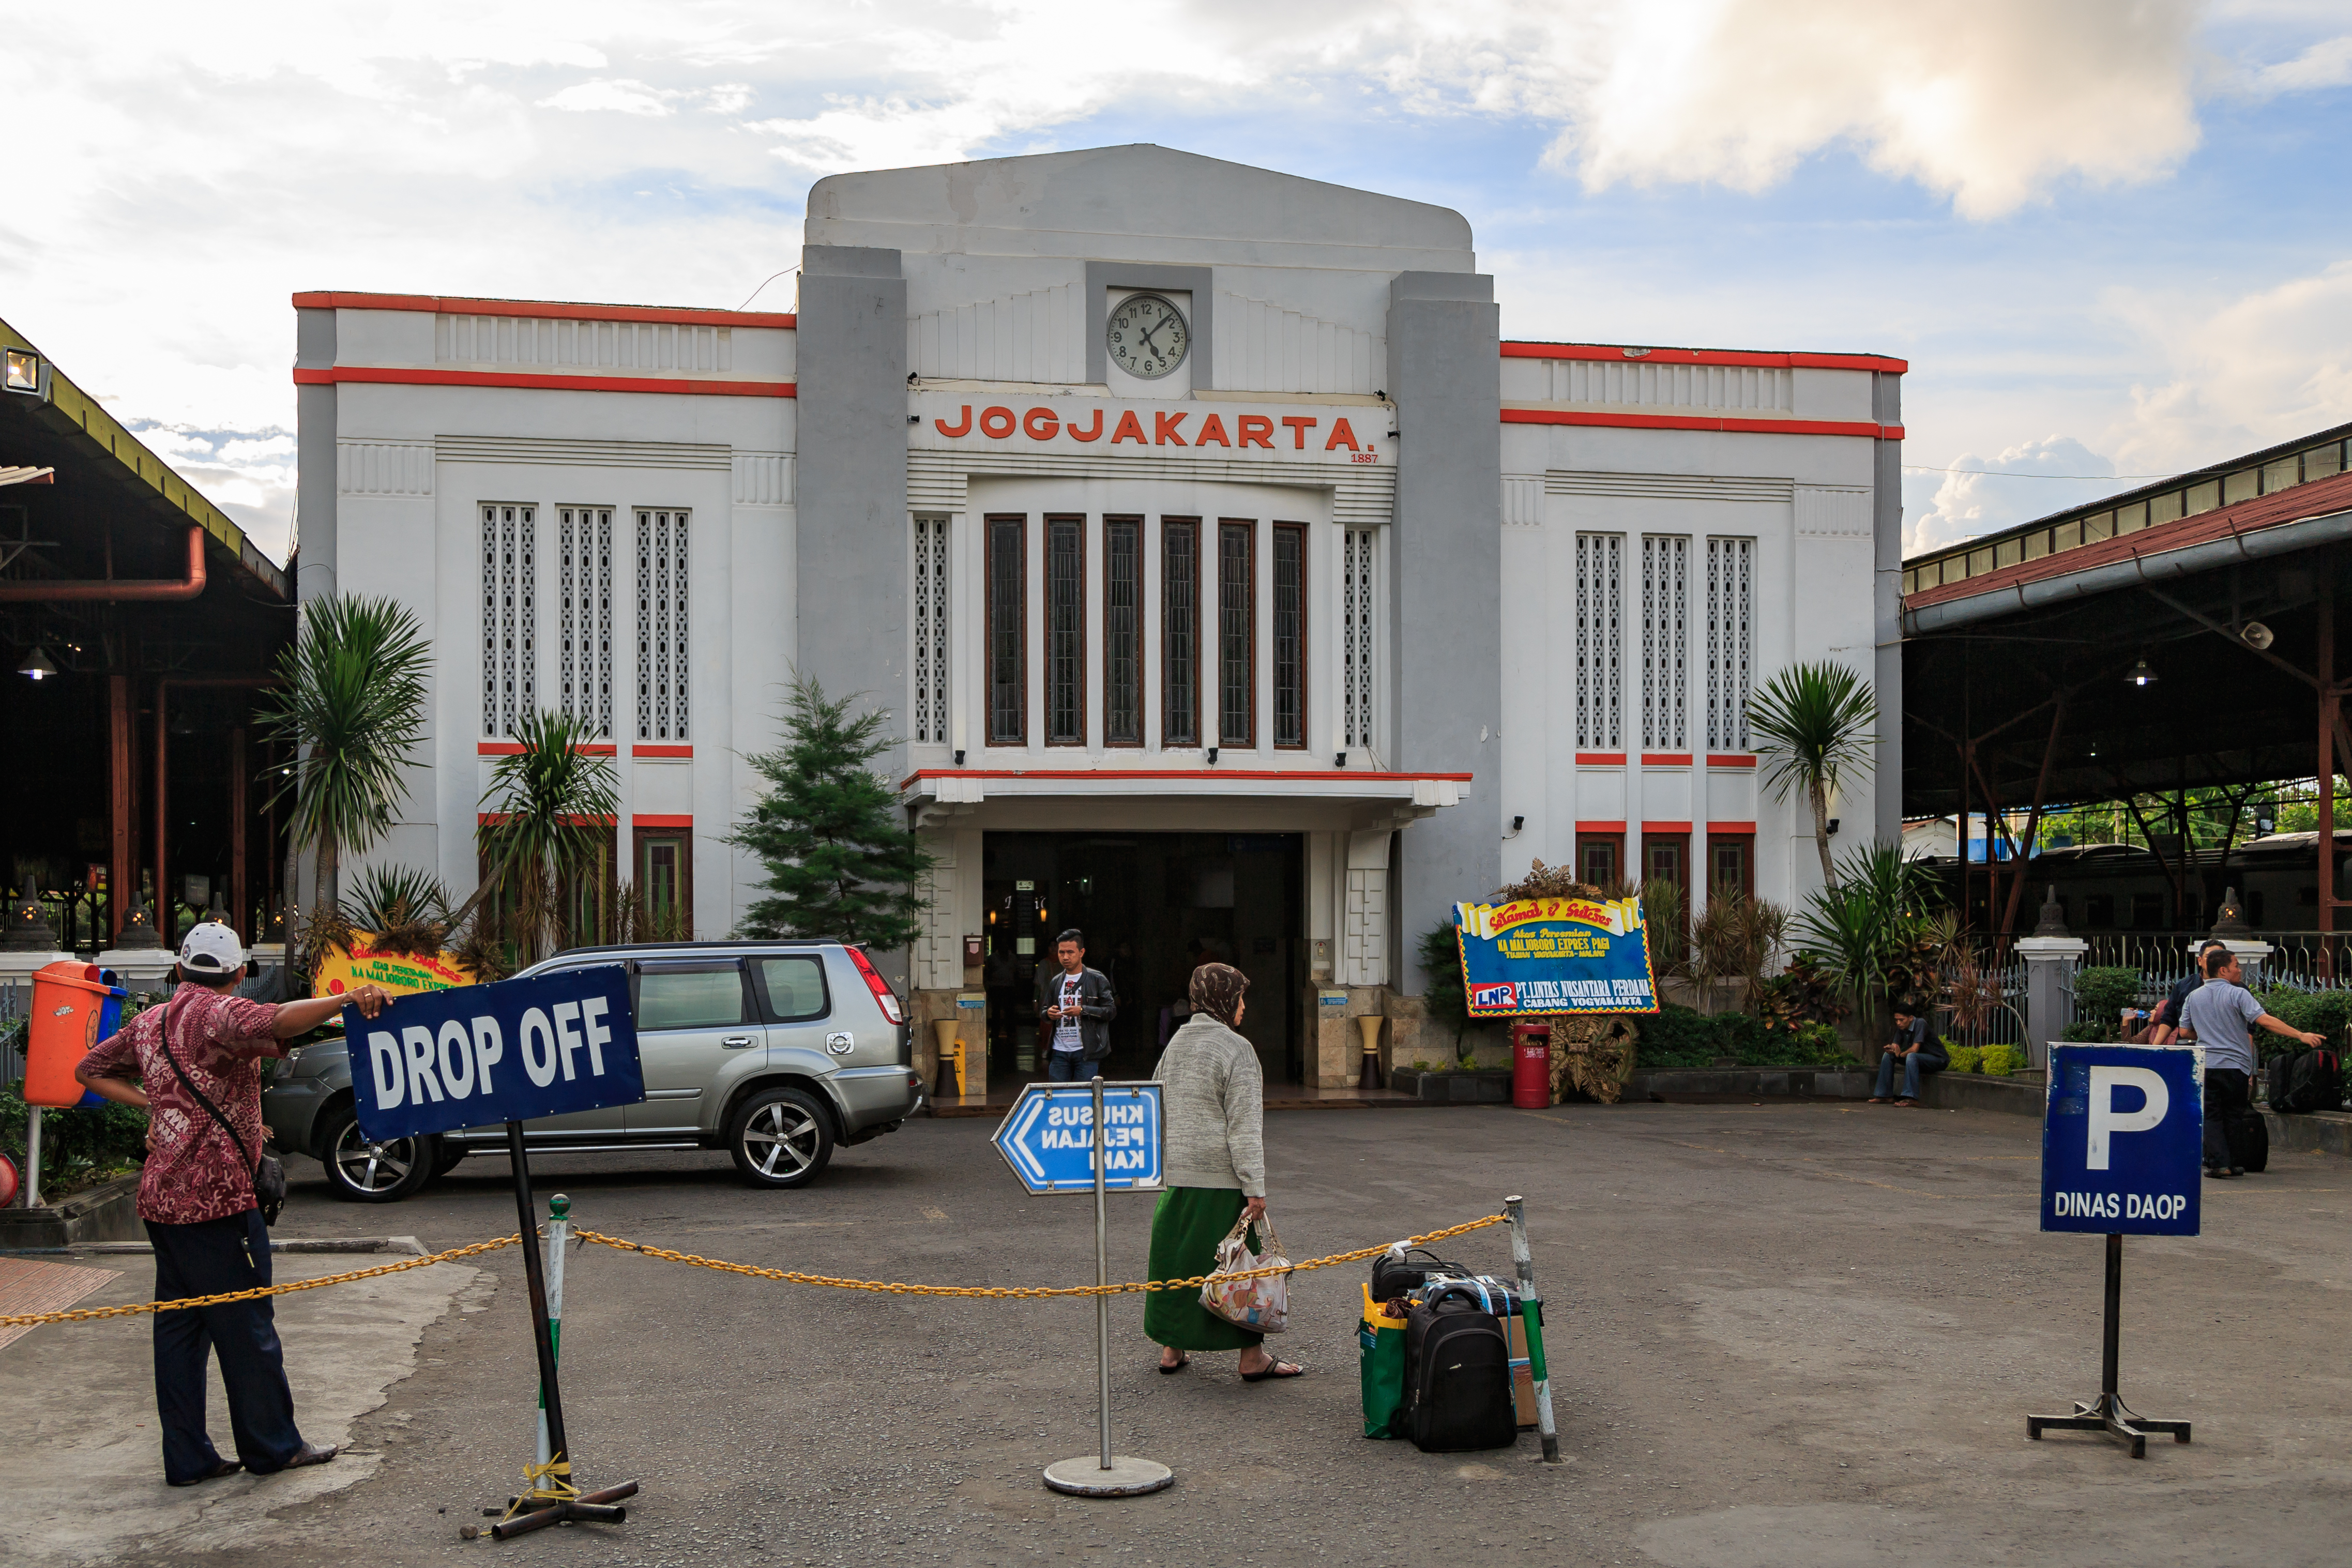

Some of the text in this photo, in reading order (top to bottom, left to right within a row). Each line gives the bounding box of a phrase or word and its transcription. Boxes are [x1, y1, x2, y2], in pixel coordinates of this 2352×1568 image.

[1129, 308, 1137, 318] 11
[1141, 304, 1152, 315] 12
[1158, 308, 1162, 318] 1
[1118, 318, 1129, 329] 10
[1168, 318, 1175, 329] 2
[1114, 331, 1122, 343] 9
[1173, 332, 1180, 343] 3
[1119, 346, 1127, 357] 8
[1168, 346, 1176, 357] 4
[1130, 357, 1137, 368] 7
[1144, 360, 1152, 372] 6
[1159, 357, 1166, 368] 5
[1350, 453, 1378, 464] 1887
[1489, 902, 1543, 931] Selamat
[1566, 903, 1613, 926] Sukses
[1540, 928, 1591, 938] Peresmian
[1497, 937, 1610, 952] KA MALIOBORO EXPRES PAGI
[1505, 951, 1530, 959] TUJUAN
[351, 965, 364, 978] KA
[366, 968, 420, 988] MALIOBORO
[392, 965, 433, 981] PERESMIAN
[1560, 980, 1611, 998] NUSANTARA
[1612, 979, 1650, 997] PERDANA
[1478, 986, 1510, 1005] LNP
[1523, 997, 1643, 1008] CABANG YOGYAKARTA
[368, 996, 611, 1110] DROP OFF
[2086, 1065, 2169, 1170] P
[2055, 1192, 2187, 1220] DINAS DAOP
